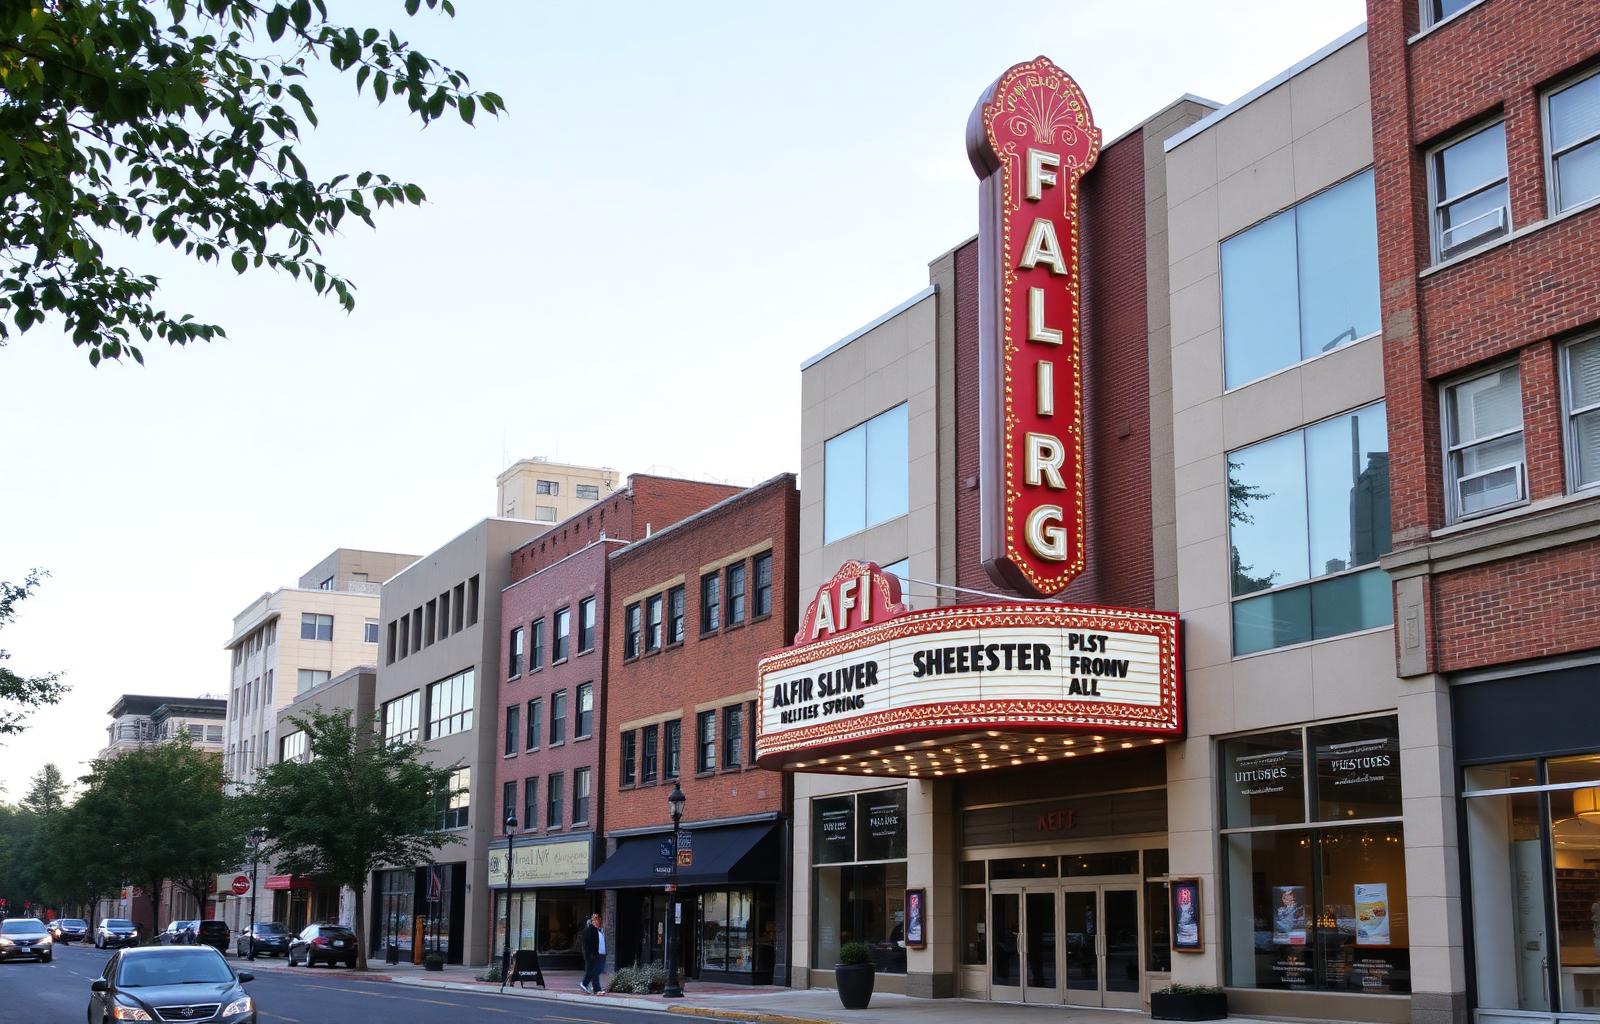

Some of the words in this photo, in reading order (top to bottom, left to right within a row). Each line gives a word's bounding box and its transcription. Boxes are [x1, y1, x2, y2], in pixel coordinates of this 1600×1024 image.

[1020, 148, 1069, 561] FALIRG
[811, 574, 870, 640] AFI
[913, 643, 1051, 678] SHEEESTER
[1068, 678, 1101, 696] ALL
